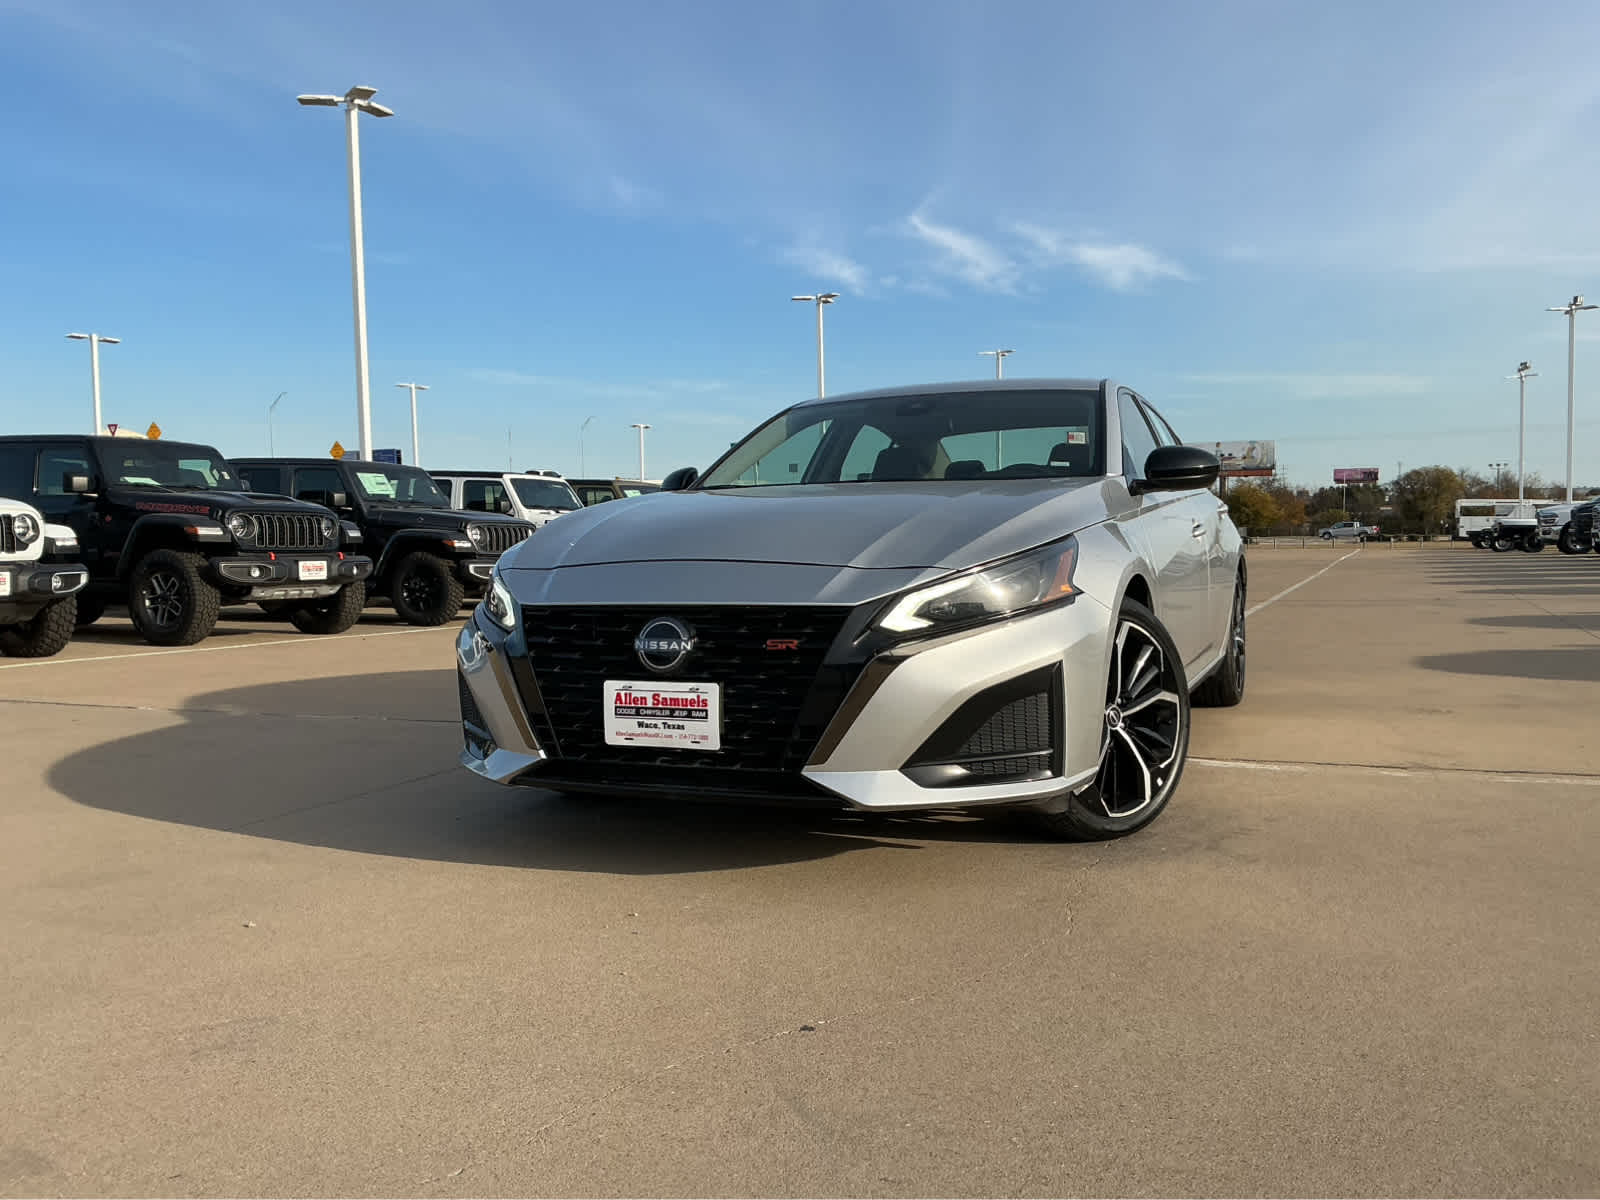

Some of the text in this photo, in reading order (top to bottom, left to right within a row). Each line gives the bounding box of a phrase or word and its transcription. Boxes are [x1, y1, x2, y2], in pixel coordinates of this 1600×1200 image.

[635, 640, 691, 650] NISSAN
[766, 639, 798, 650] SR
[614, 692, 708, 707] Allen Samuels
[616, 707, 636, 715] DODGE
[640, 708, 670, 716] CHRYSLER
[691, 710, 706, 718] RAM
[637, 721, 685, 730] Waco, Texas
